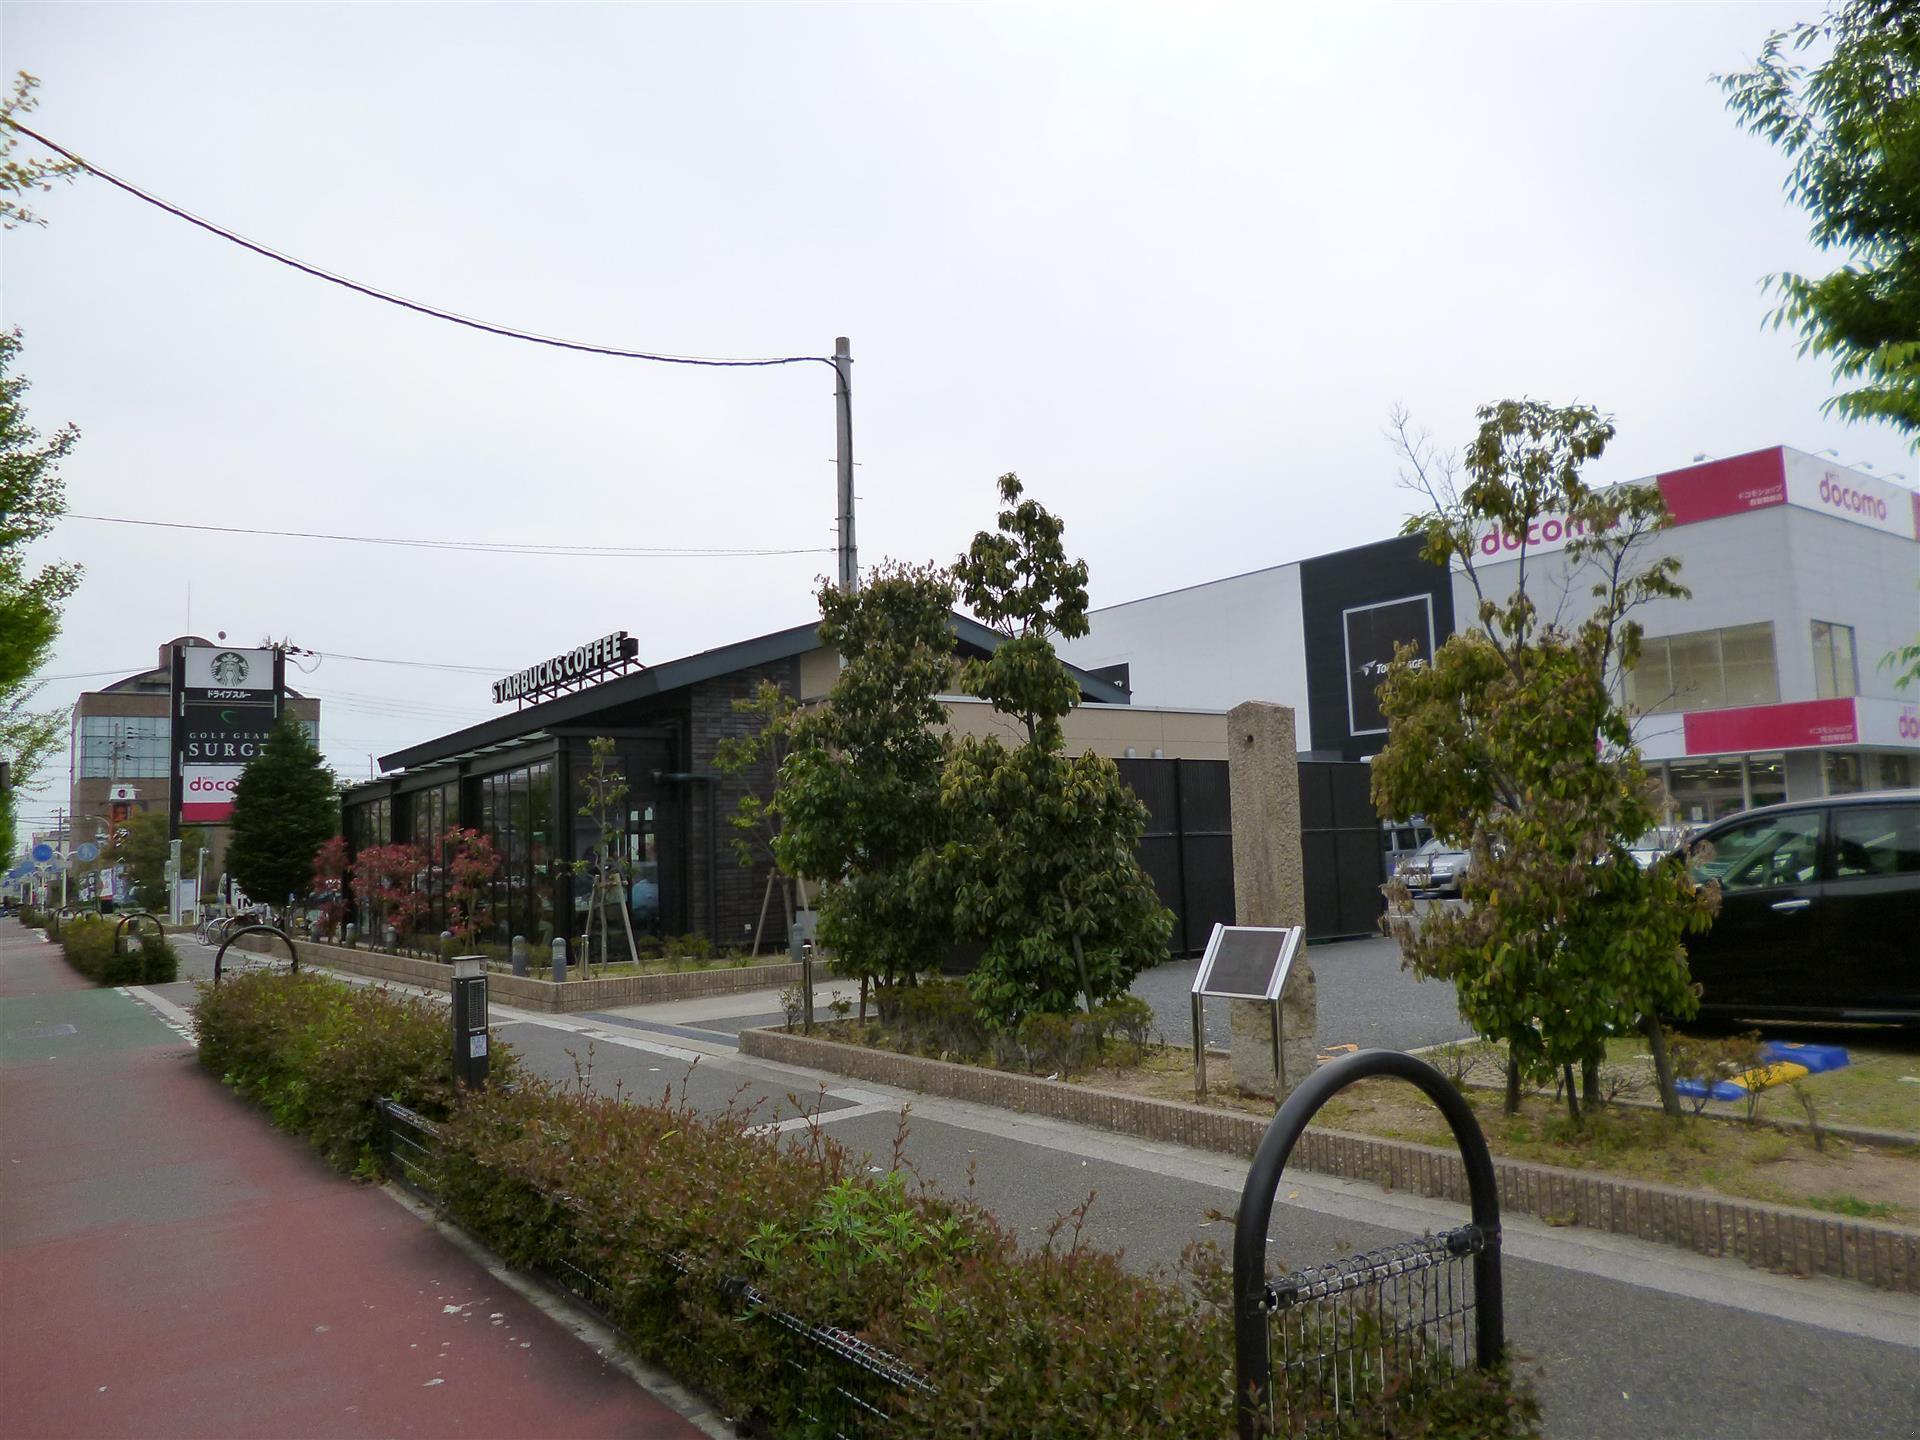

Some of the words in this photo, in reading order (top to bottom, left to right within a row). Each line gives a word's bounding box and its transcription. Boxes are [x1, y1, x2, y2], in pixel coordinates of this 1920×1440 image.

[1820, 472, 1887, 520] docomo
[491, 654, 563, 704] STARBUCKS
[564, 631, 622, 677] COFFEE
